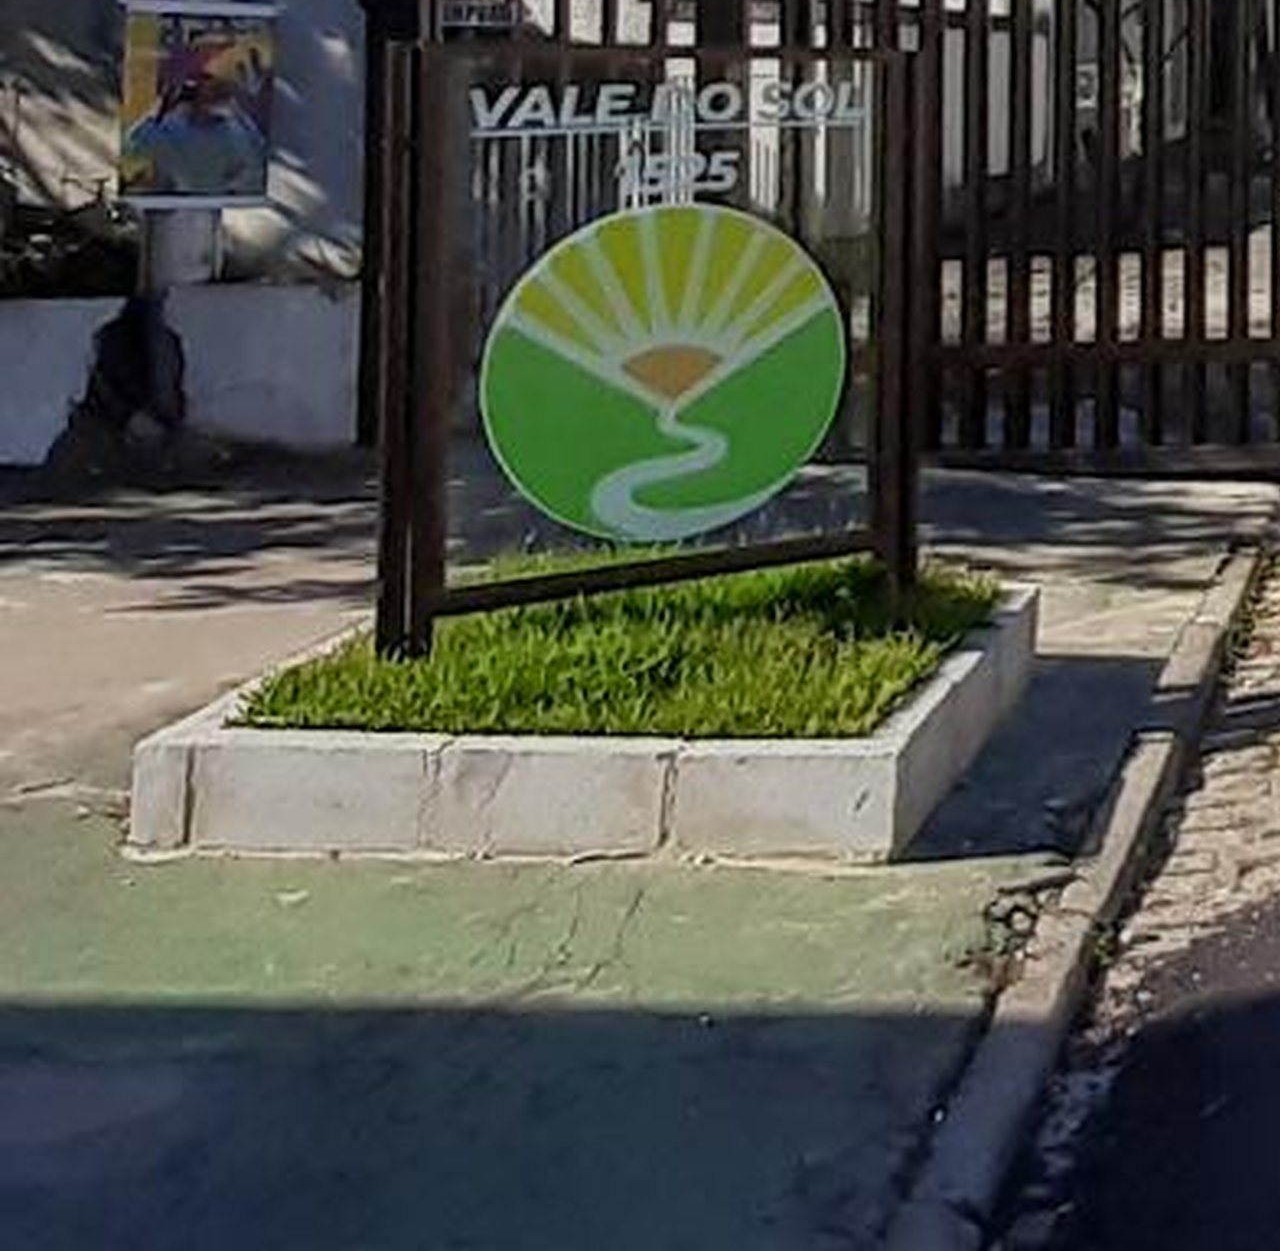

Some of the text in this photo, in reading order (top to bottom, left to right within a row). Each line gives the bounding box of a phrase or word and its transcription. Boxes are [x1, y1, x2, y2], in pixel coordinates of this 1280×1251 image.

[469, 78, 867, 129] VALE DO SOL
